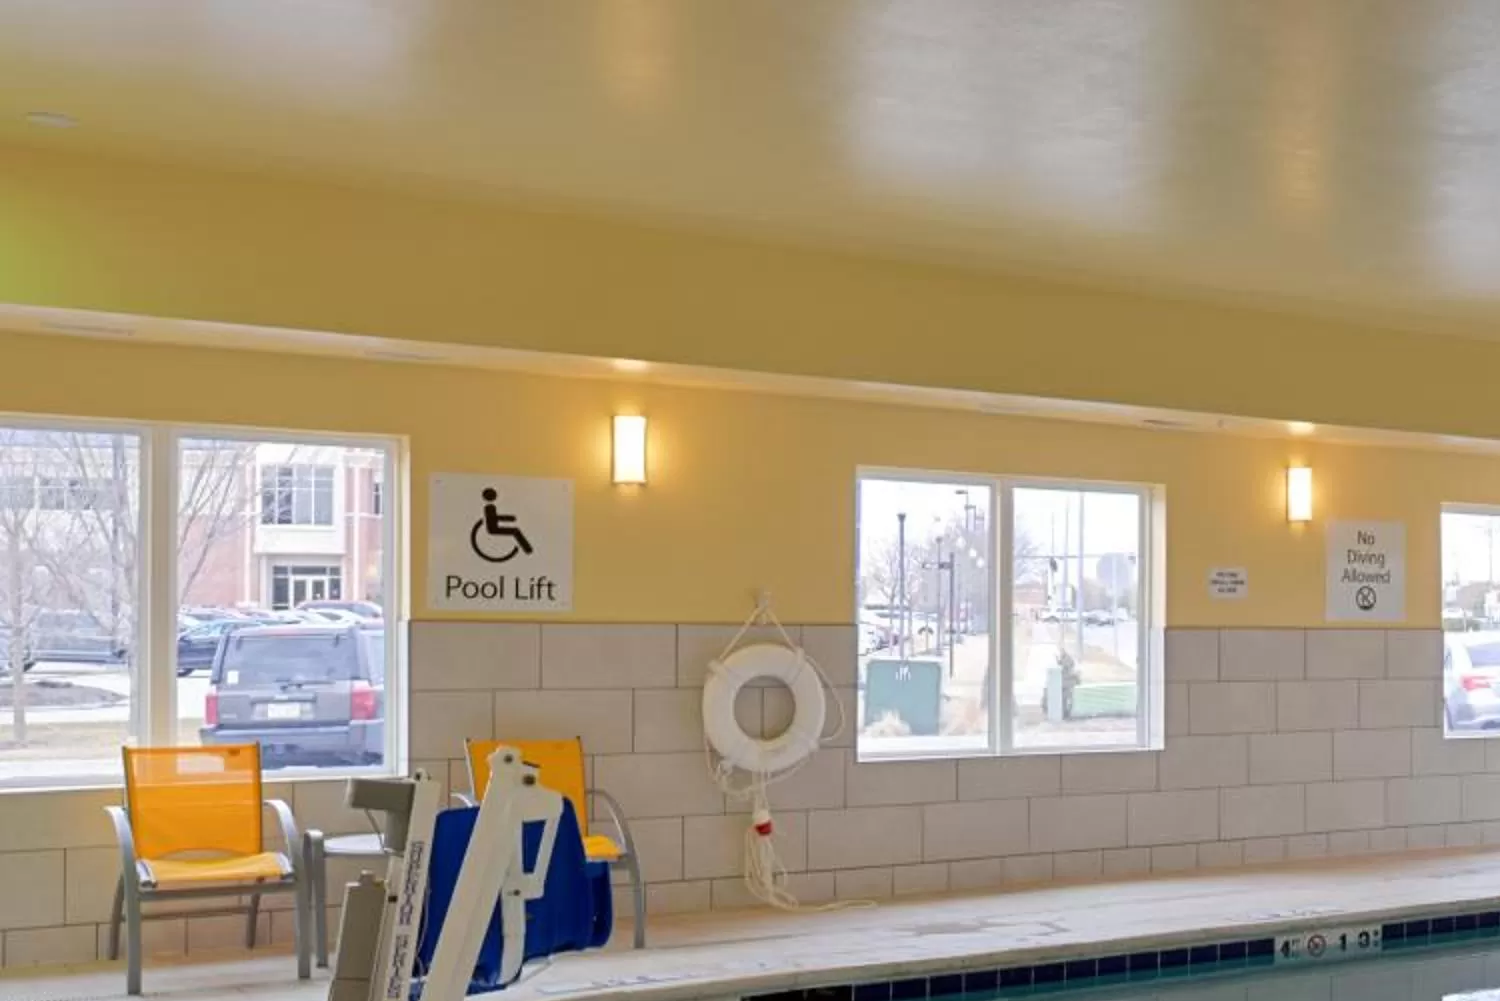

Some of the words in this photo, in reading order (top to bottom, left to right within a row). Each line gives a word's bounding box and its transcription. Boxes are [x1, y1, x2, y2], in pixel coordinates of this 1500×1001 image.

[1357, 530, 1375, 545] No
[1347, 549, 1385, 569] Diving
[1340, 567, 1391, 584] Allowed
[445, 575, 505, 599] Pool
[515, 575, 556, 600] Lift
